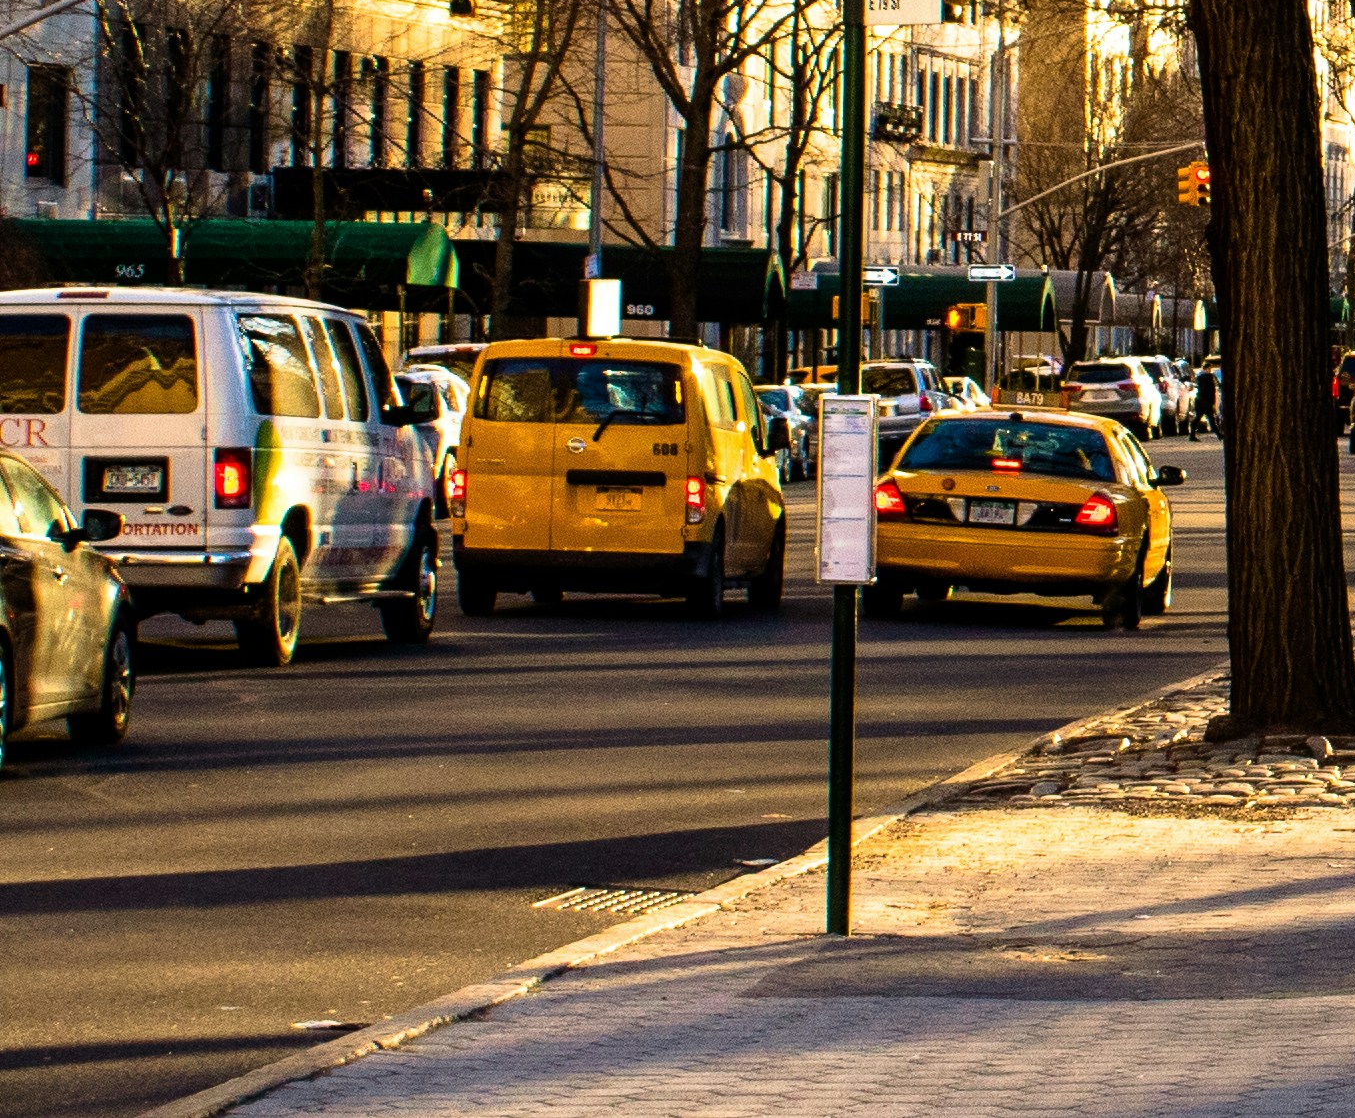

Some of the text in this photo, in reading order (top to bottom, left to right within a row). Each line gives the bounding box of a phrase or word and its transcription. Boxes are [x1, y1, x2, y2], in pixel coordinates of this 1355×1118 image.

[115, 264, 145, 278] 965
[626, 304, 653, 315] 960
[1016, 392, 1044, 405] 8A79
